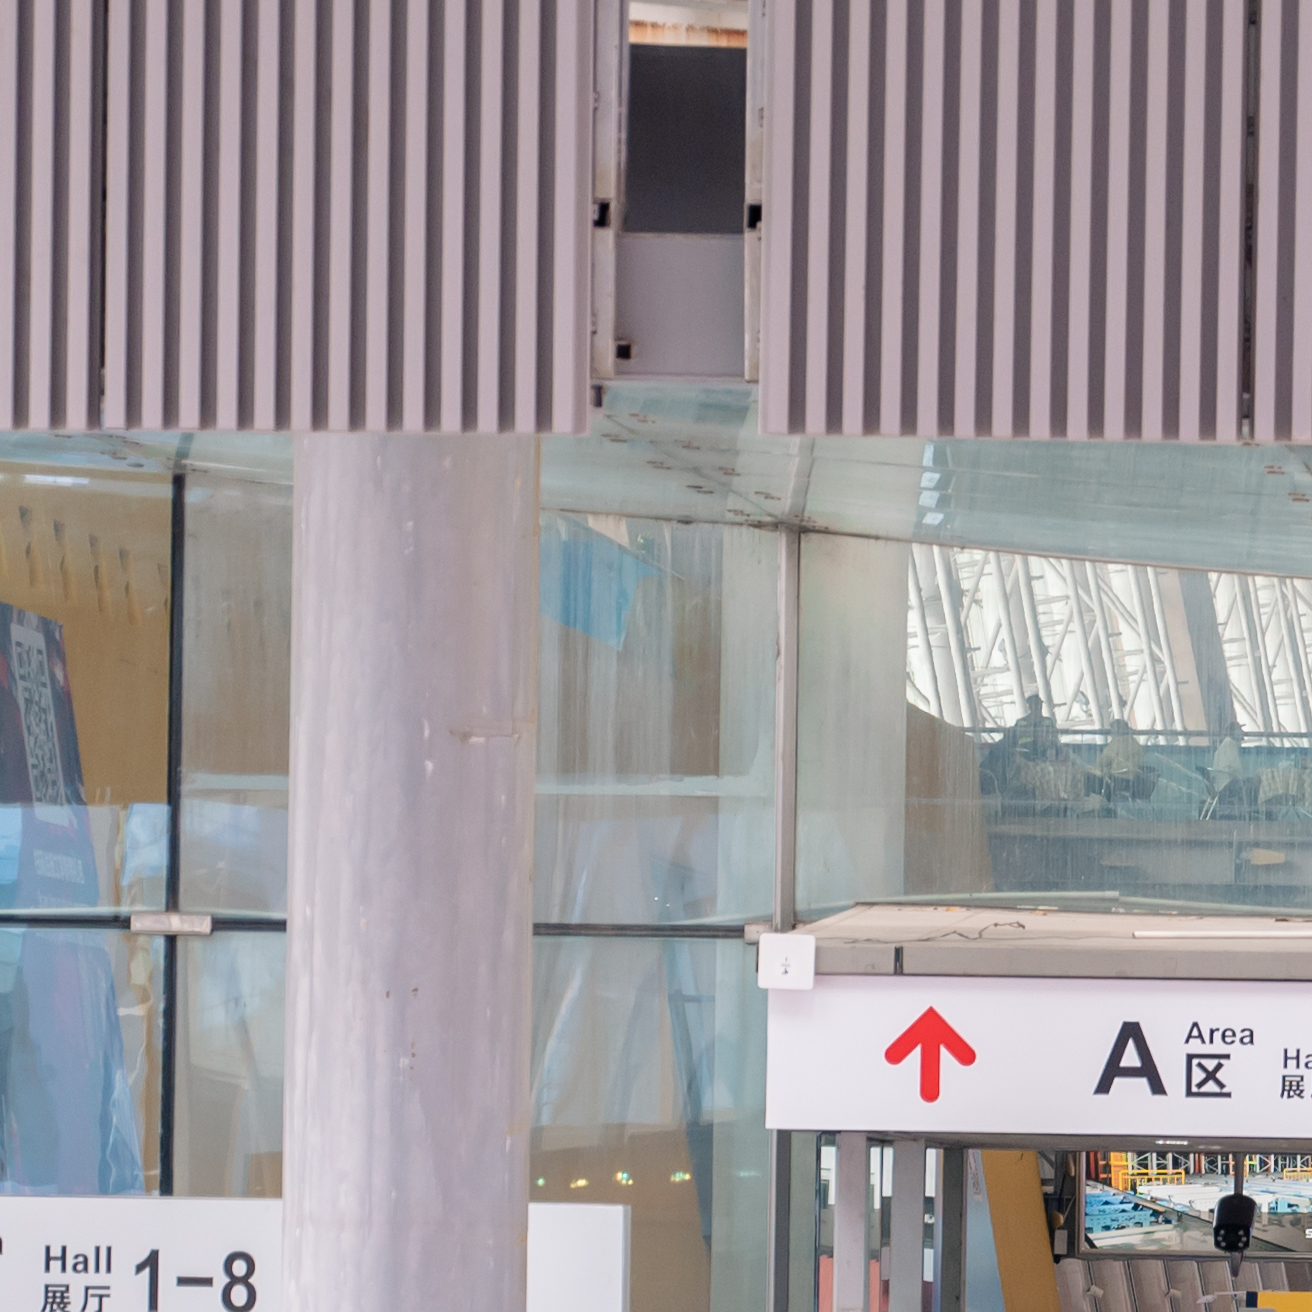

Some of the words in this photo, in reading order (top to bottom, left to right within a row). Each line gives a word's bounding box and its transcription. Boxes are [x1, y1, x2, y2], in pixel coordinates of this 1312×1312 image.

[1185, 1022, 1254, 1045] Area
[1093, 1021, 1167, 1096] A
[1186, 1053, 1231, 1098] 区
[45, 1245, 111, 1273] Hall
